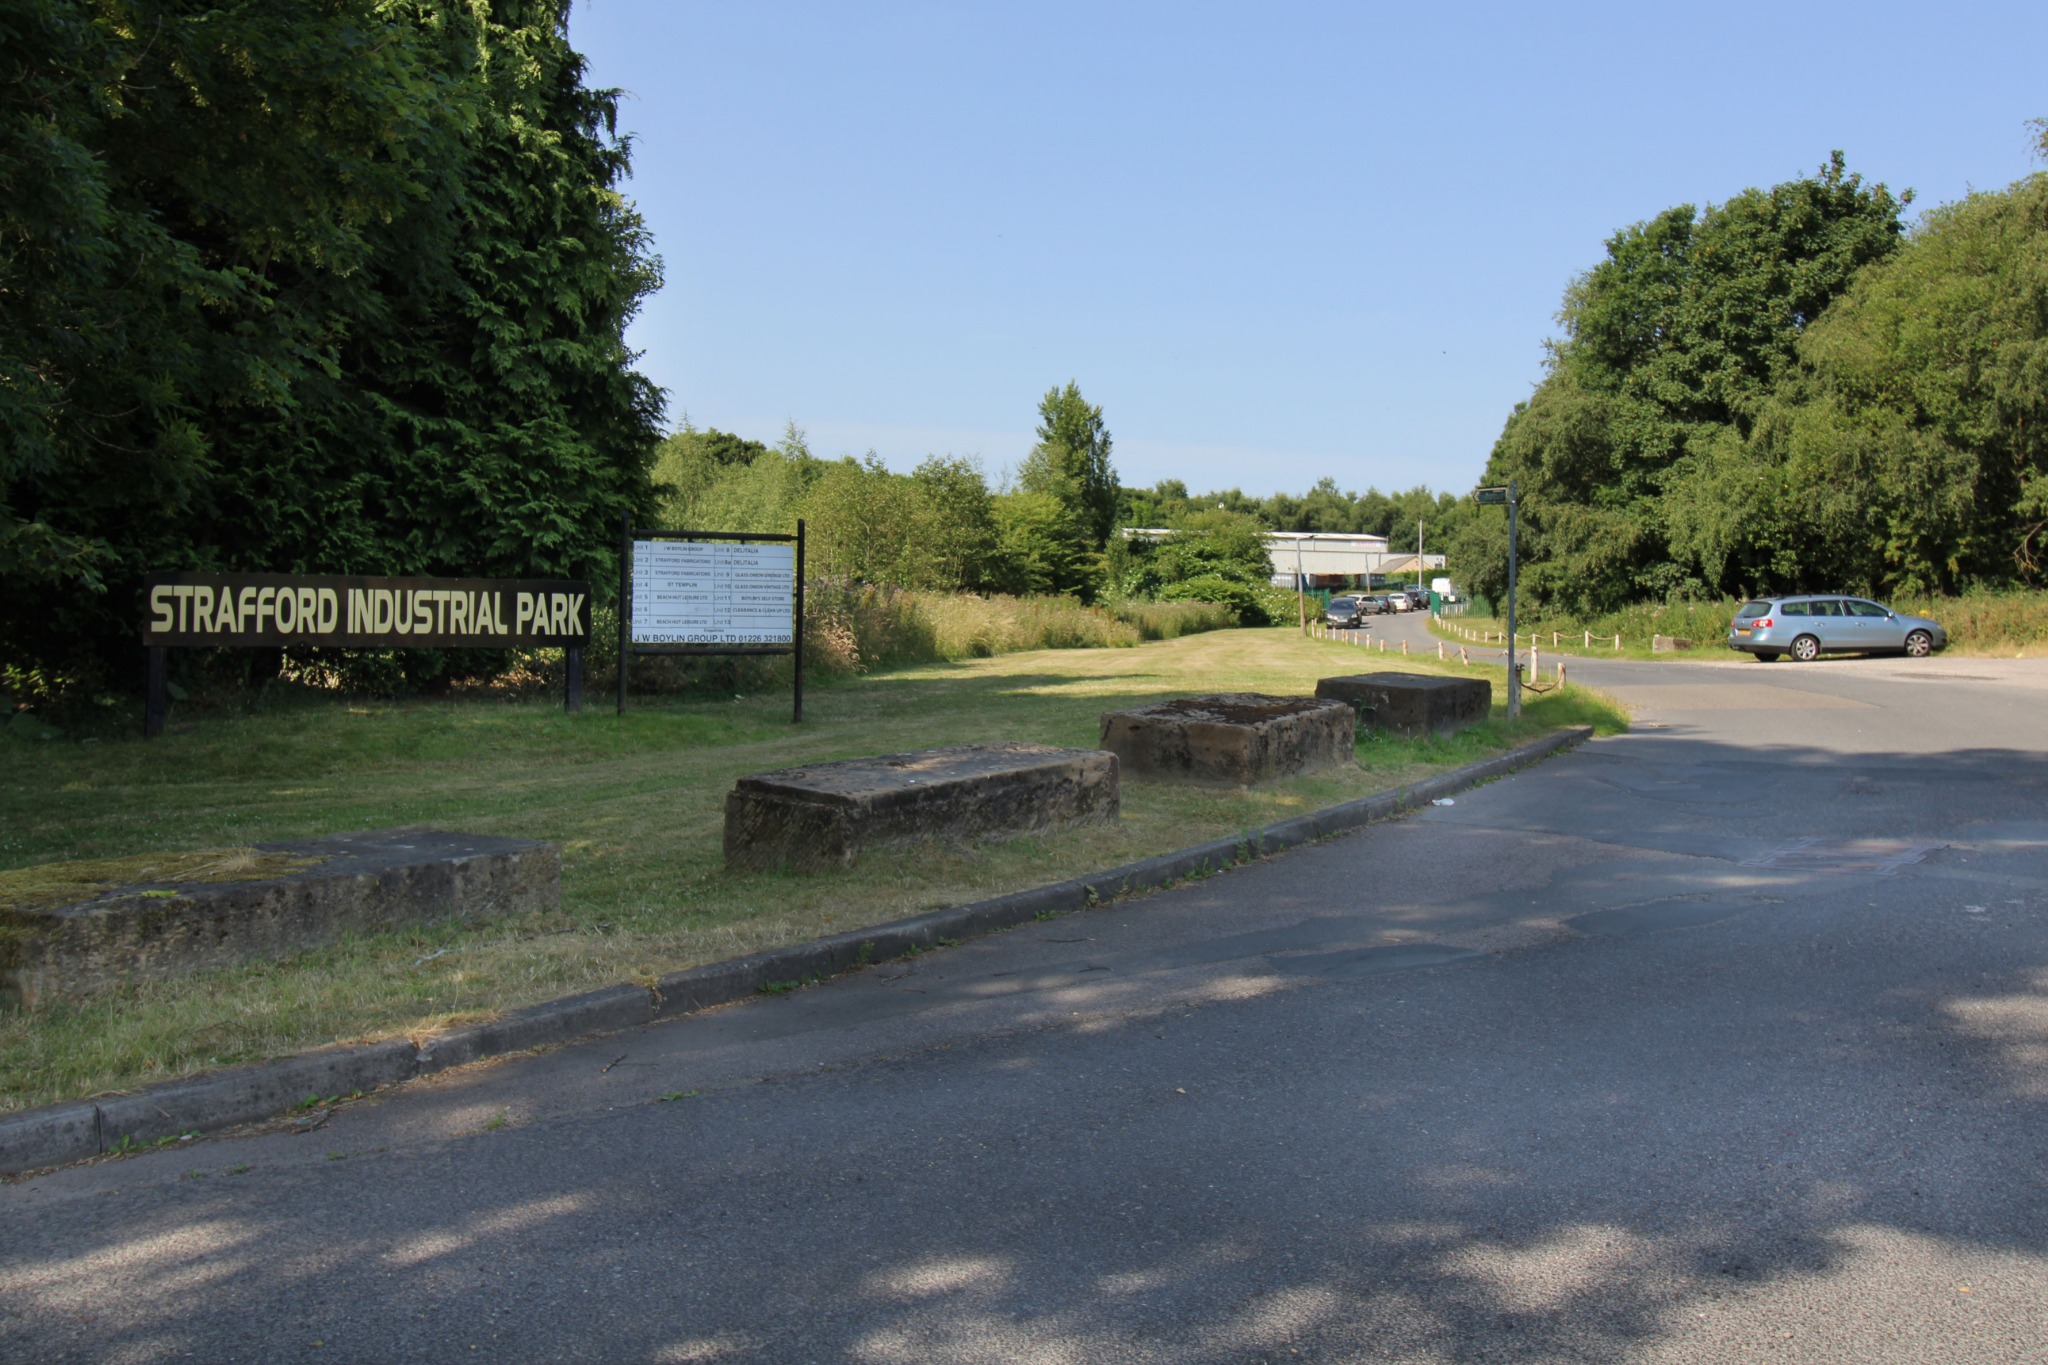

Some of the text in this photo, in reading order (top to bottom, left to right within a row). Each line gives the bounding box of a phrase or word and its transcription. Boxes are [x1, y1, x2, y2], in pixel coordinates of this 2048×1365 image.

[150, 584, 586, 636] STRAFFORD INDUSTRIAL PARK
[634, 634, 791, 643] J W BOYLIN GROUP LTD 01226 321800
